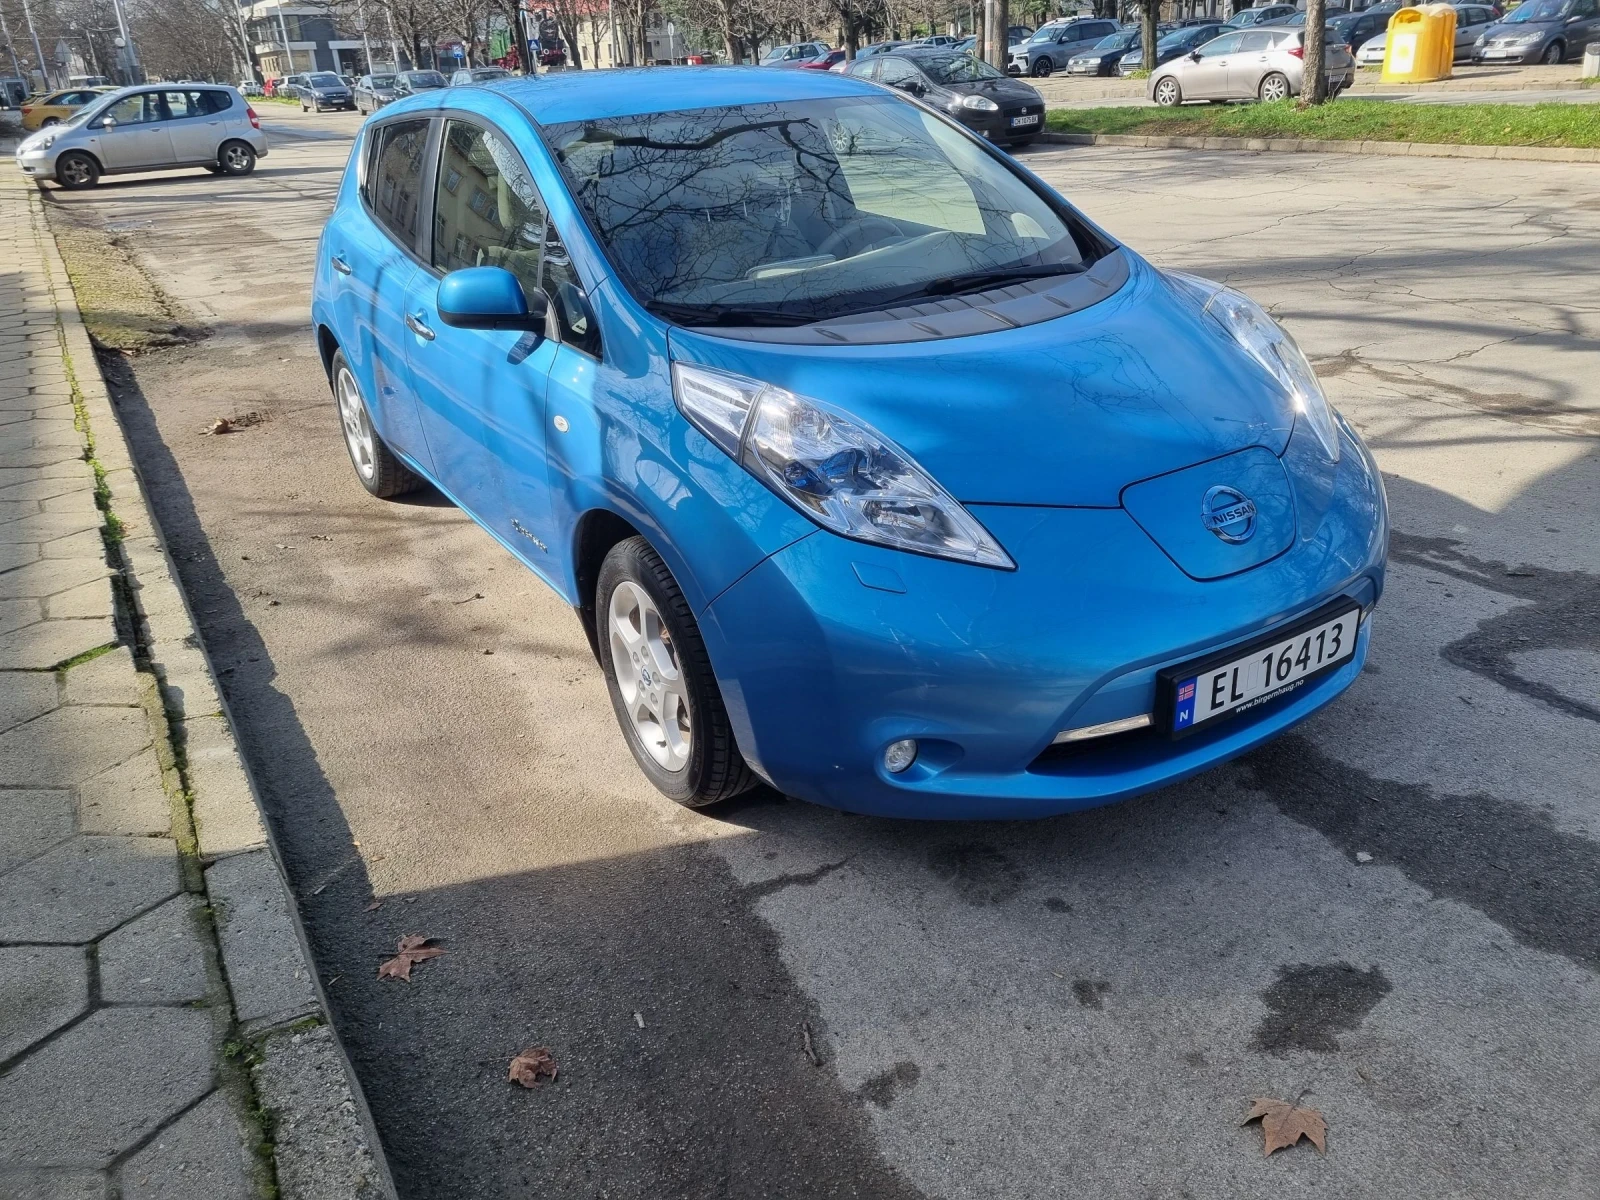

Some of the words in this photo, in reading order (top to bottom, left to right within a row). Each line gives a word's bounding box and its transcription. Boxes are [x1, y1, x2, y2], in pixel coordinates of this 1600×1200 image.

[1212, 503, 1254, 525] NISSAN
[1210, 667, 1244, 711] EL
[1262, 622, 1344, 688] 16413
[1179, 709, 1189, 723] N
